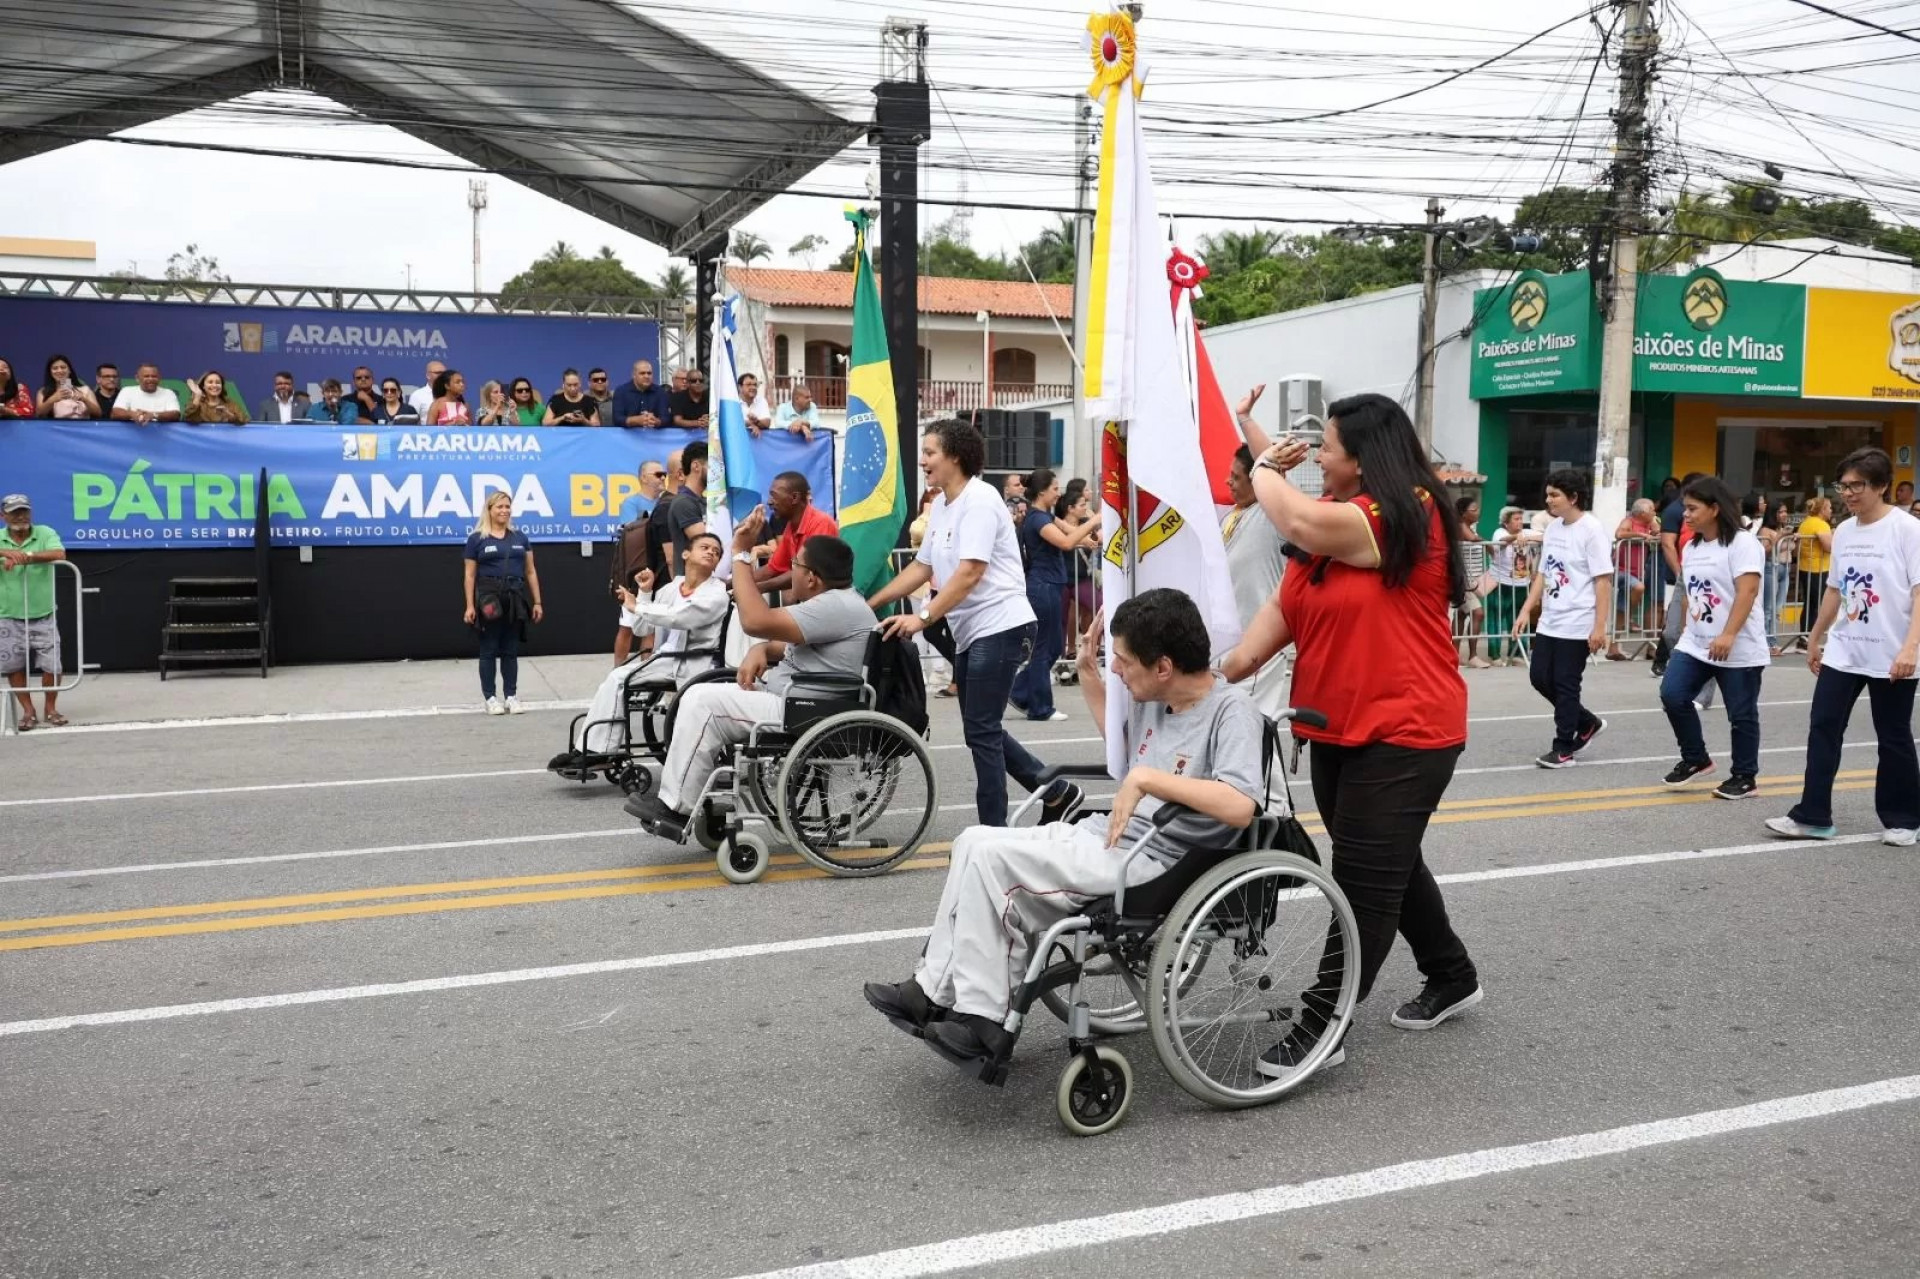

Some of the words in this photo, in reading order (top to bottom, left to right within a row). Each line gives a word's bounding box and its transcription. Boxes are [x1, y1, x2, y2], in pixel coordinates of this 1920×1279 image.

[286, 324, 448, 348] ARARUAMA
[1478, 339, 1520, 358] Paixões
[1521, 336, 1537, 353] de
[1538, 332, 1577, 351] Minas
[1633, 332, 1694, 357] aixões
[1698, 335, 1722, 358] de
[1727, 335, 1784, 361] Minas
[286, 346, 369, 356] PREFEITURA
[377, 350, 448, 359] MUNICIPAL
[397, 433, 541, 453] ARARUAMA
[397, 453, 471, 461] PREFEITURA
[72, 458, 307, 521] PÁTRIA
[321, 473, 554, 519] AMADA
[75, 528, 155, 540] ORGULHO
[163, 528, 183, 539] DE
[191, 528, 219, 538] SER
[227, 527, 328, 538] BRAILEIRO.
[335, 526, 384, 537] FRUTO
[390, 526, 409, 536] DA
[417, 525, 458, 536] LUTA,
[582, 523, 600, 534] DA
